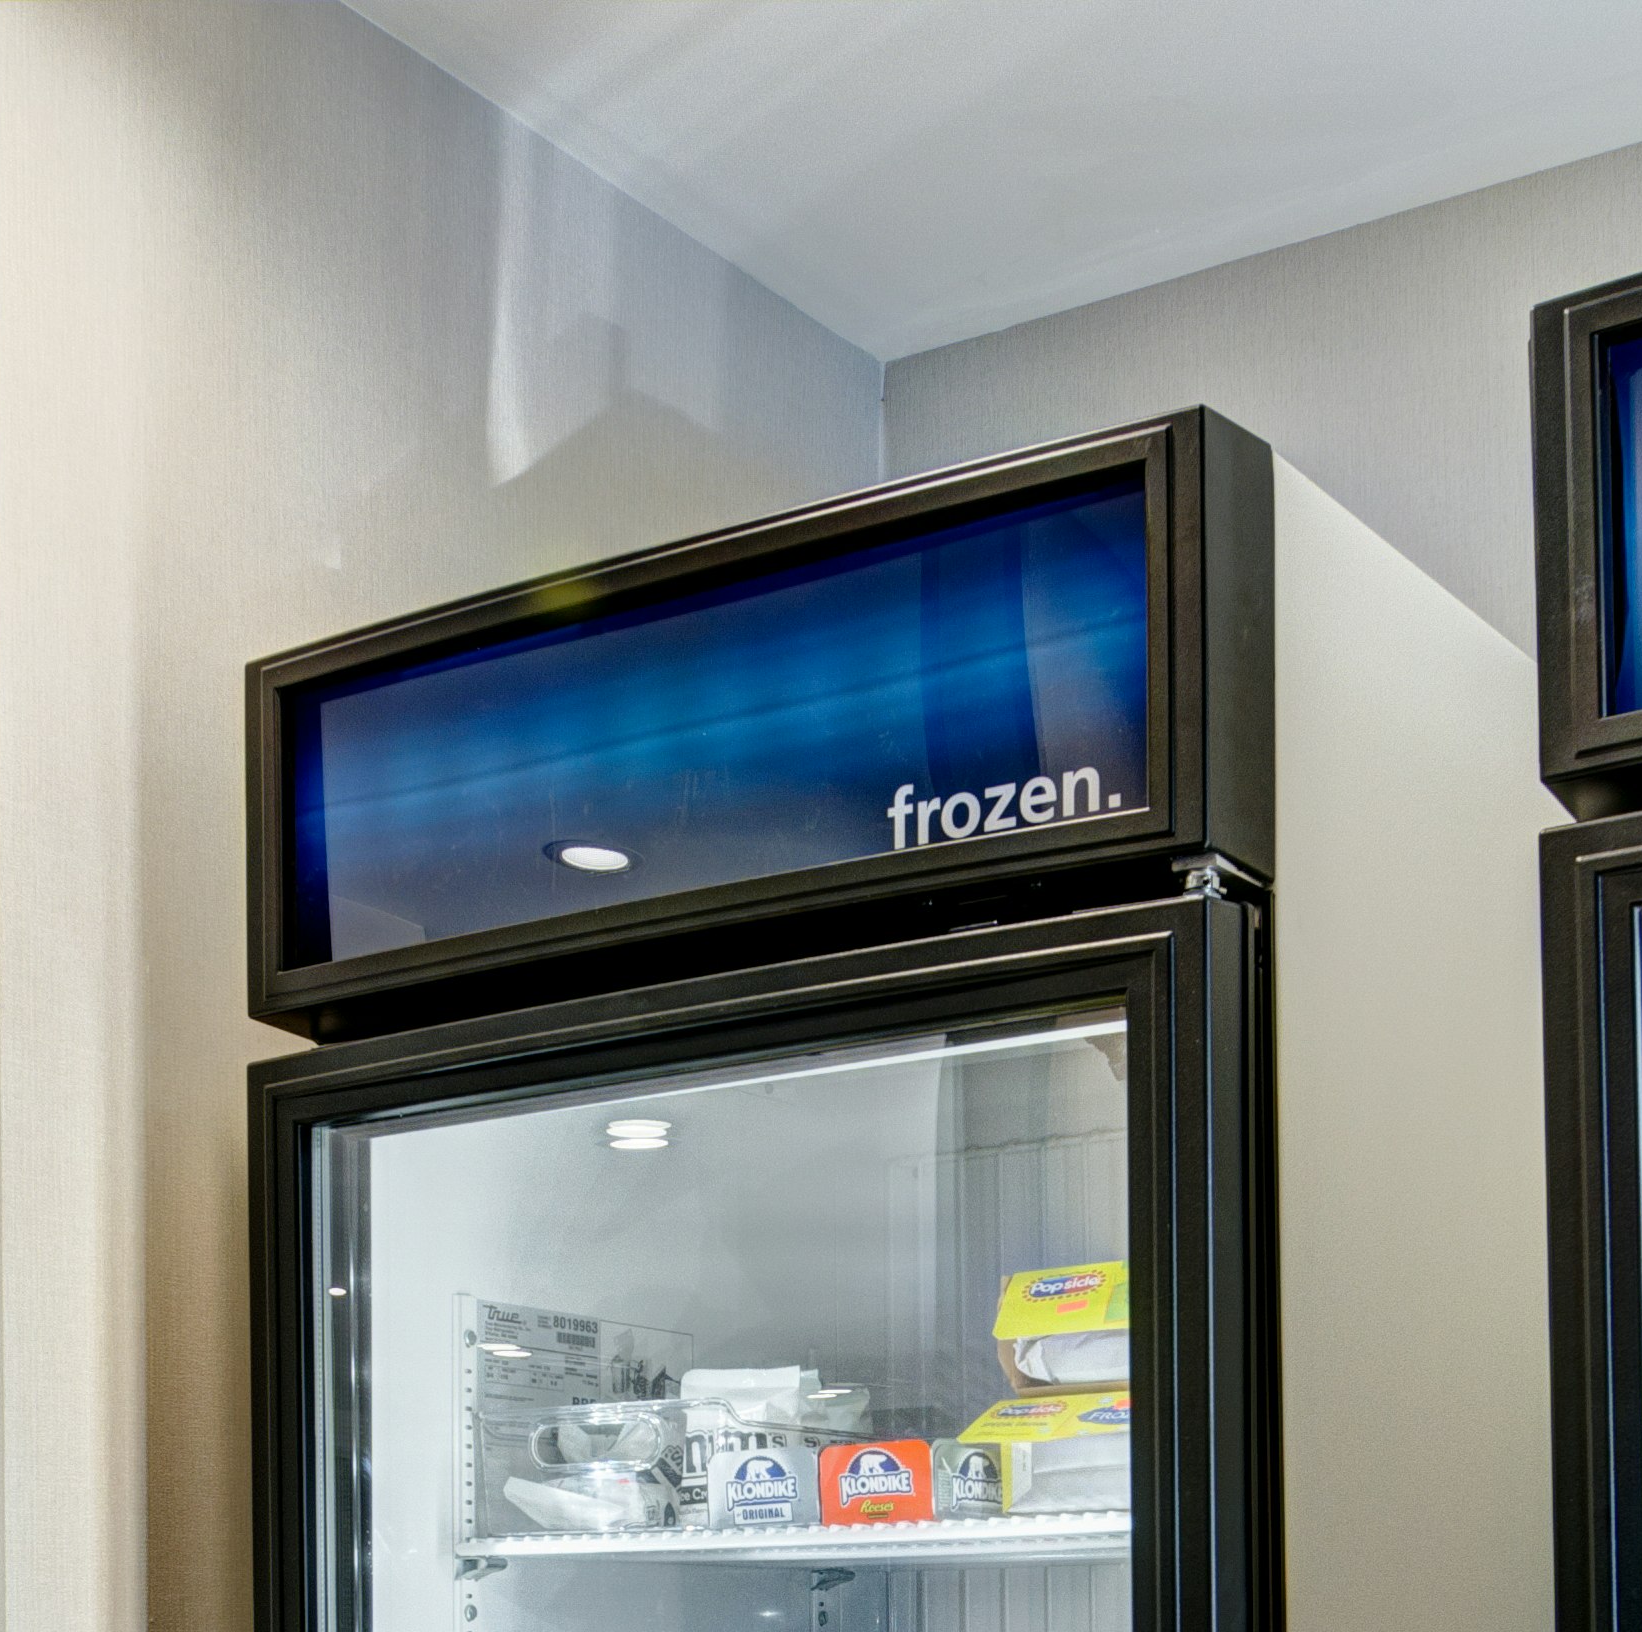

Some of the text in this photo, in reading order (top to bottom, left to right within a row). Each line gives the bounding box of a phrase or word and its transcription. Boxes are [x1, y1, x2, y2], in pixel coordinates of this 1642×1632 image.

[887, 766, 1122, 850] frozen.
[1029, 1274, 1101, 1297] Popsicle
[552, 1315, 598, 1334] 8019963
[727, 1476, 797, 1511] KLONDIKE
[839, 1471, 913, 1508] KLONDIKE
[742, 1507, 785, 1520] ORIGINAL
